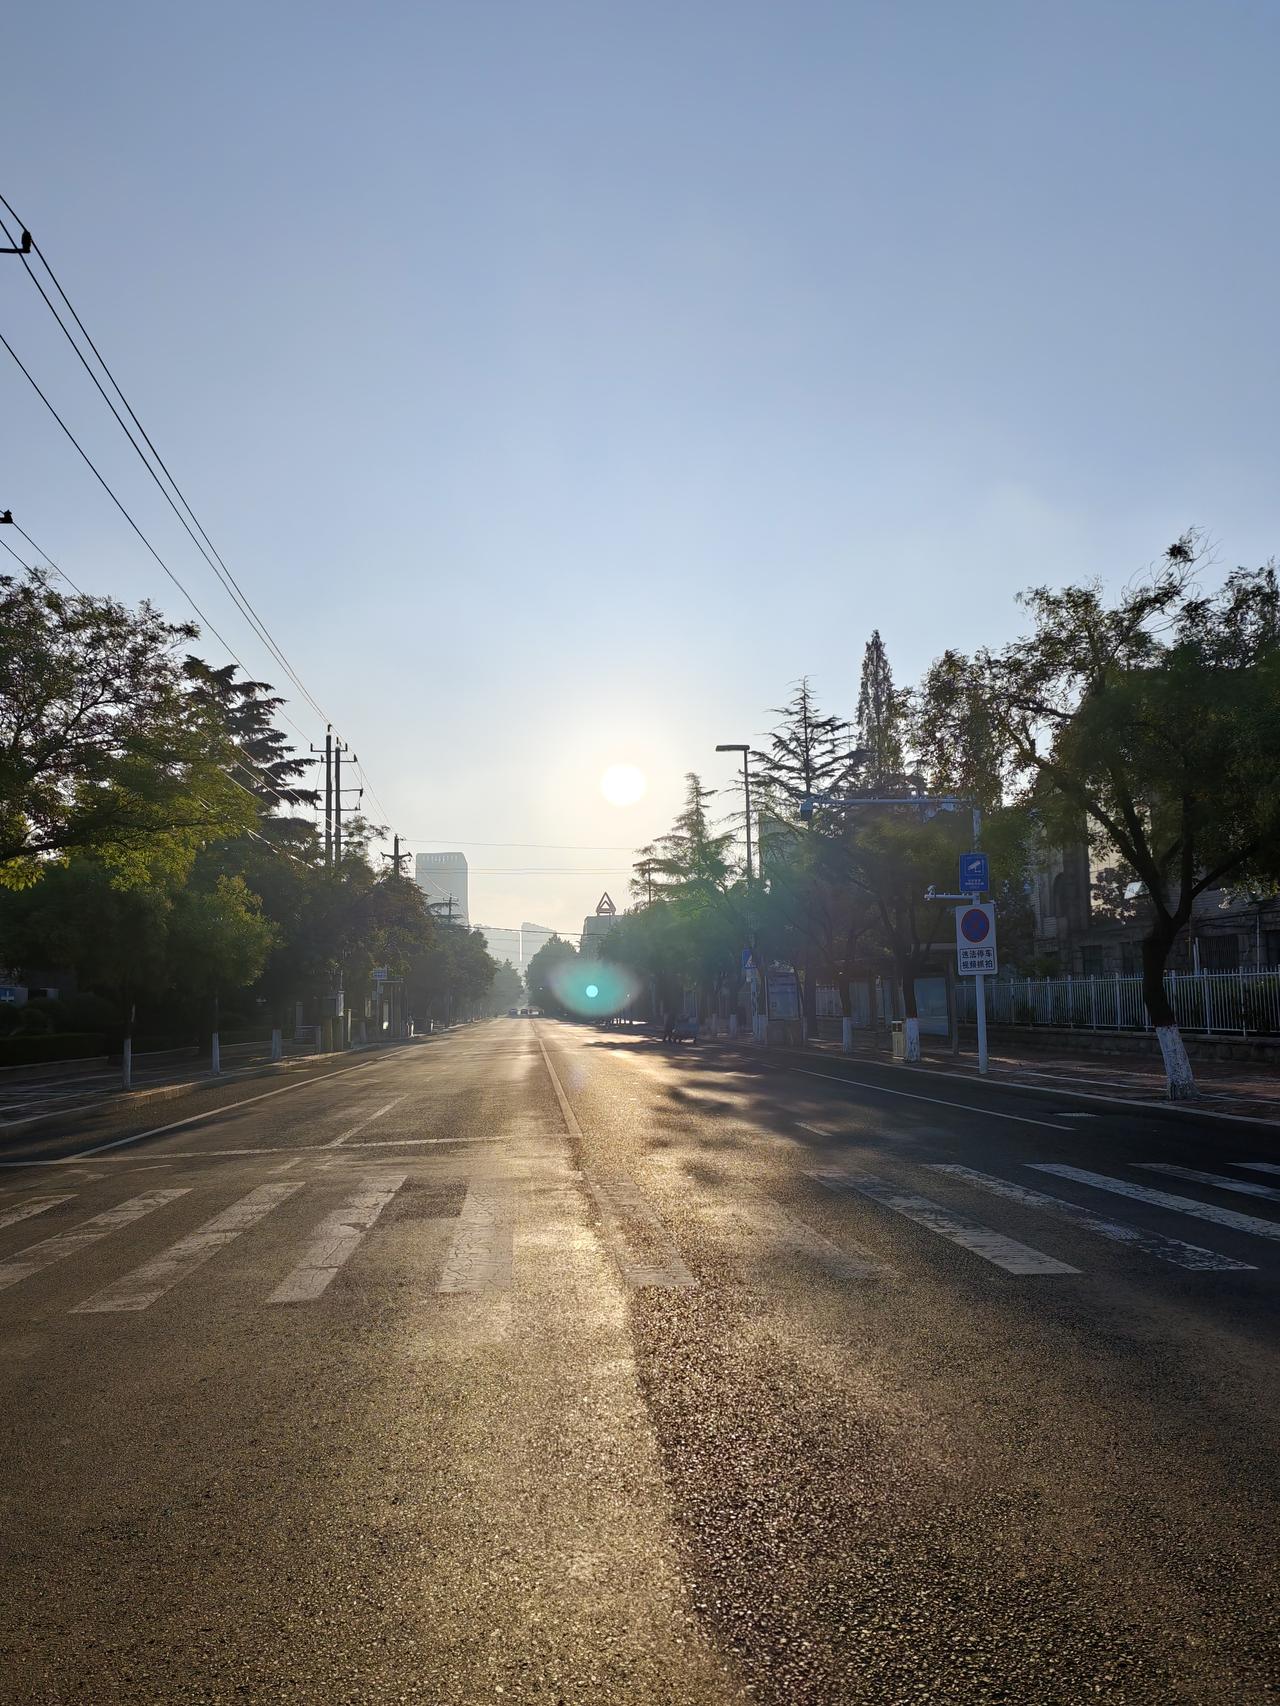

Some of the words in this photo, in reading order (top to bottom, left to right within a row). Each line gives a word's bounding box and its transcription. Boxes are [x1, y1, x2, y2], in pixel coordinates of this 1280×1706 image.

[962, 949, 992, 958] 违法停车
[962, 959, 993, 969] 视频抓拍
